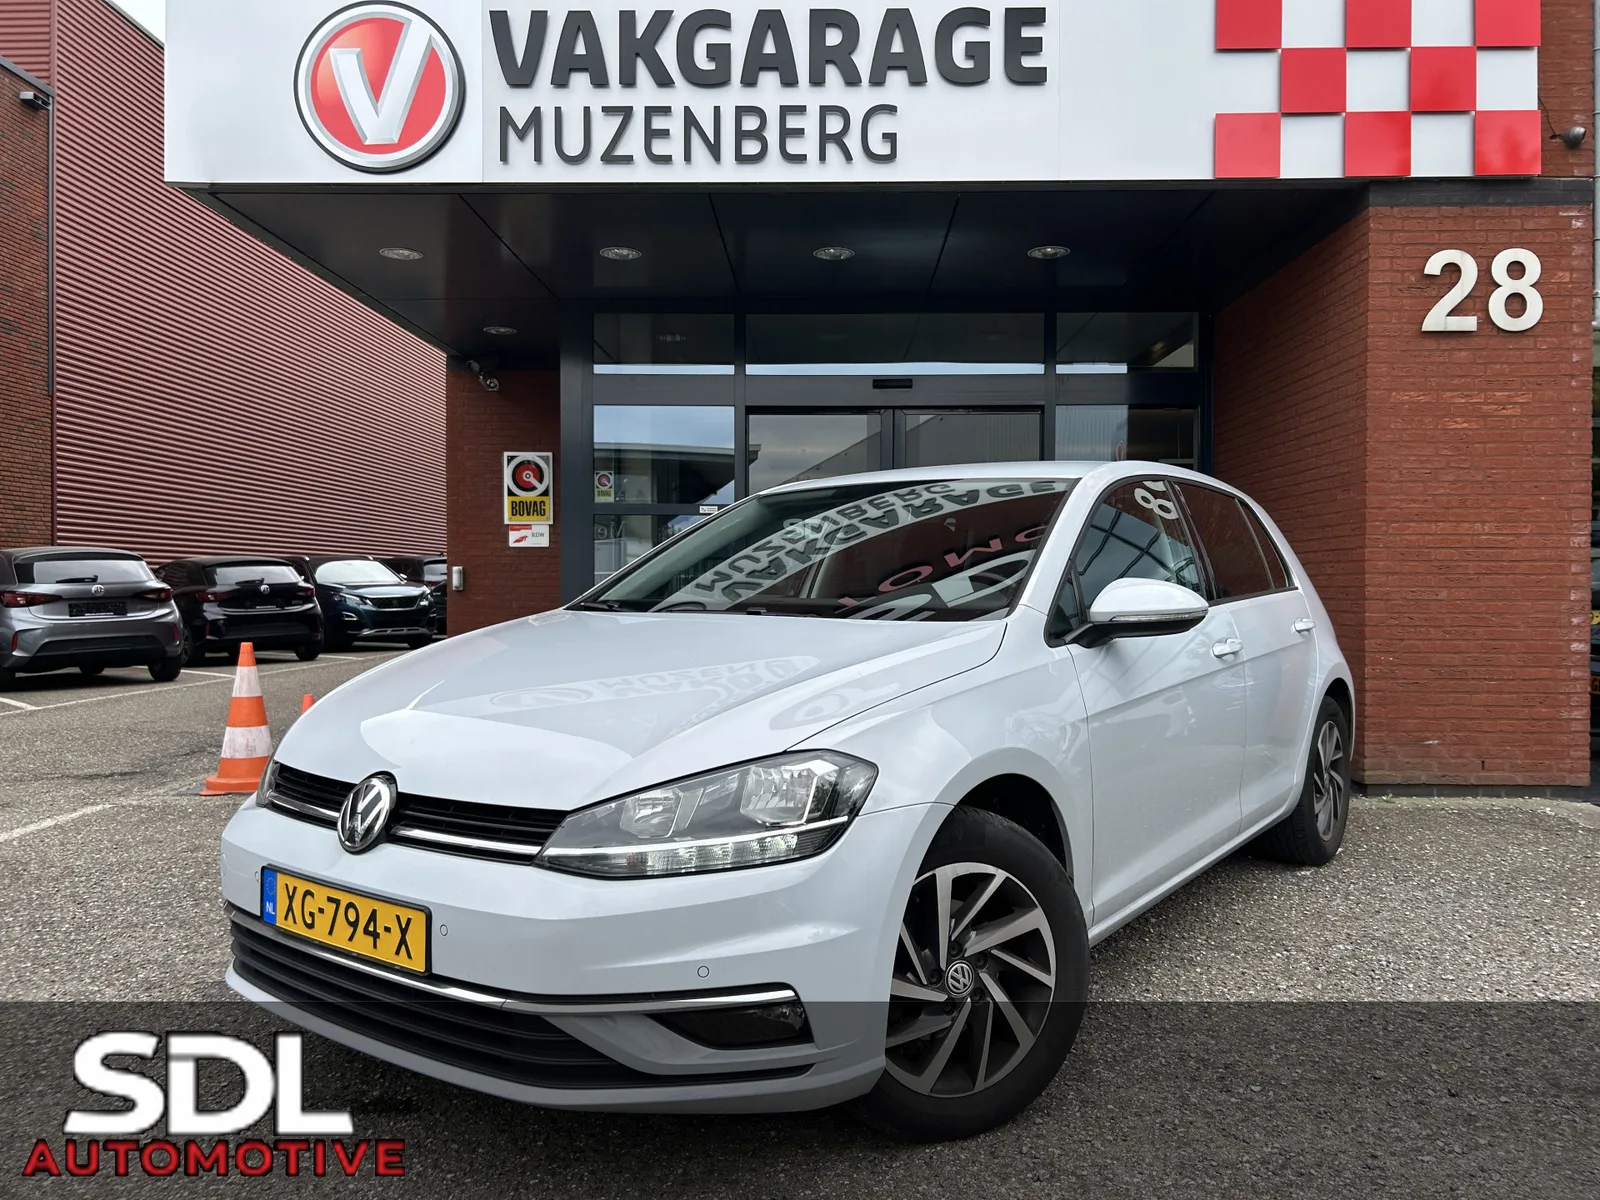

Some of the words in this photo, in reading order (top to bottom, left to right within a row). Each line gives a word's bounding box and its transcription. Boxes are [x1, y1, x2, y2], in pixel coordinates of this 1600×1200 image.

[489, 7, 1047, 87] VAKGARAGE
[499, 104, 899, 163] MUZENBERG
[1421, 248, 1543, 332] 28
[511, 500, 546, 517] BOVAG
[597, 488, 611, 497] BOVAG
[265, 901, 276, 915] NL
[283, 882, 413, 960] XG-794-X
